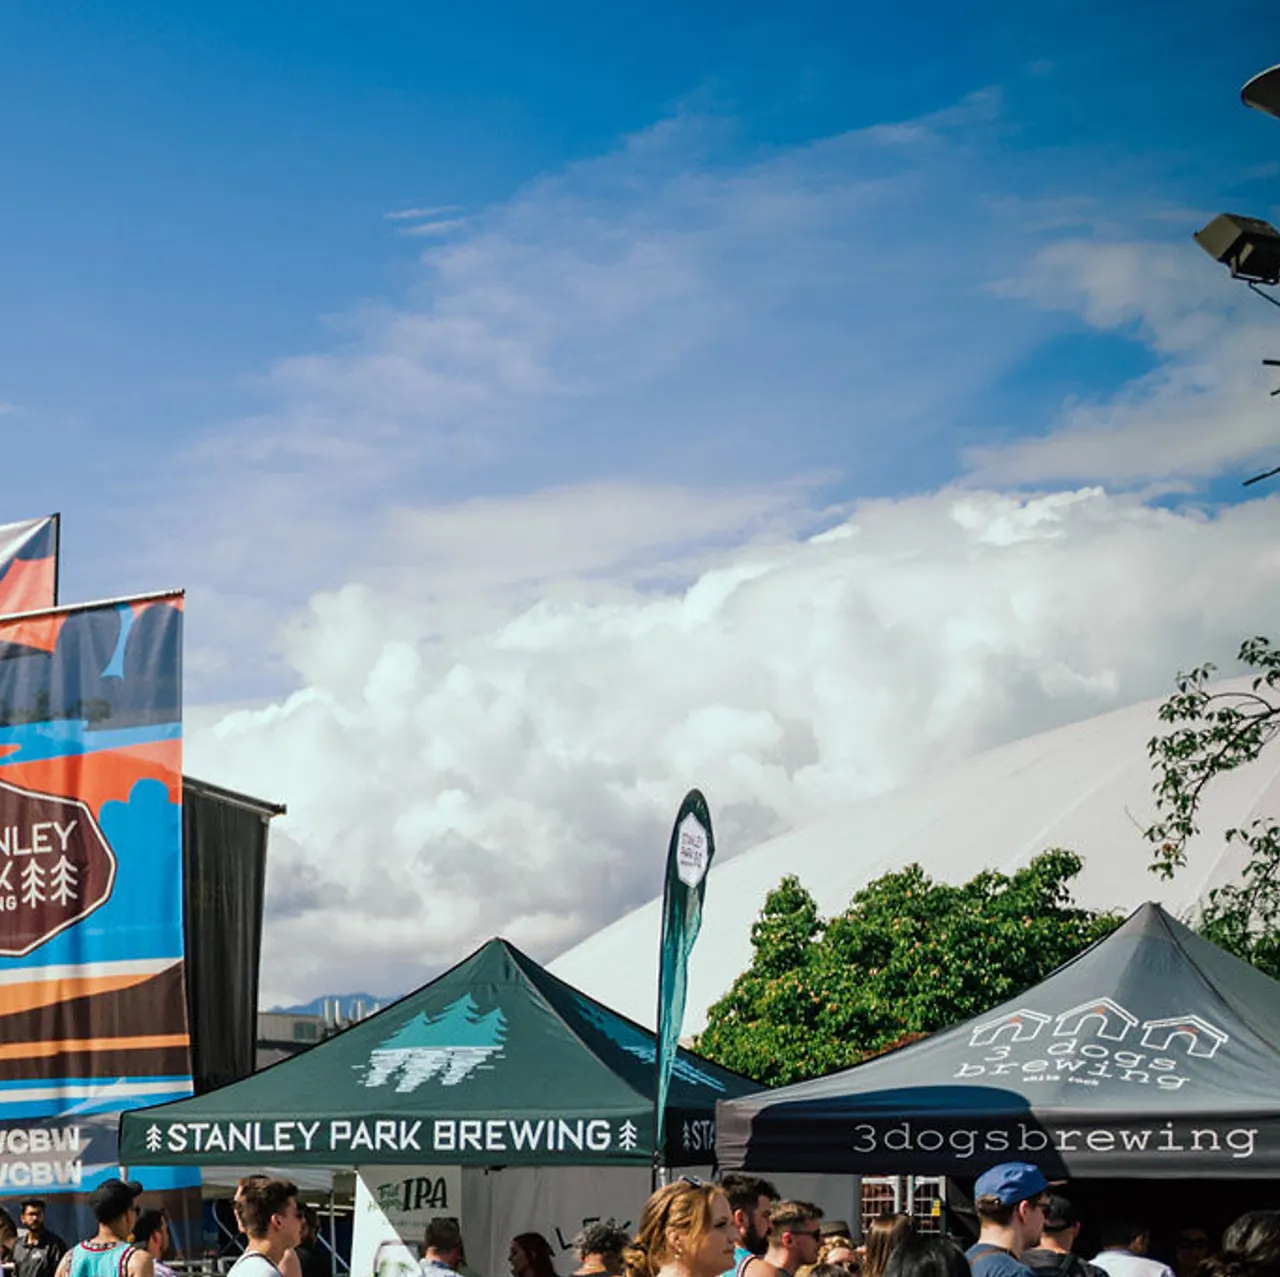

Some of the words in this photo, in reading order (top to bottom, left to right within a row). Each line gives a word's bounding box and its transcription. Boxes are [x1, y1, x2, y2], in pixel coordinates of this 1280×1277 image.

[984, 1046, 1011, 1061] 3
[1047, 1039, 1177, 1070] dogs
[953, 1058, 1190, 1090] brewing
[167, 1121, 320, 1152] STANLEY
[330, 1120, 422, 1151] PARK
[434, 1120, 611, 1151] BREWING
[853, 1122, 1259, 1159] 3dogsbrewing
[402, 1176, 448, 1212] IPA
